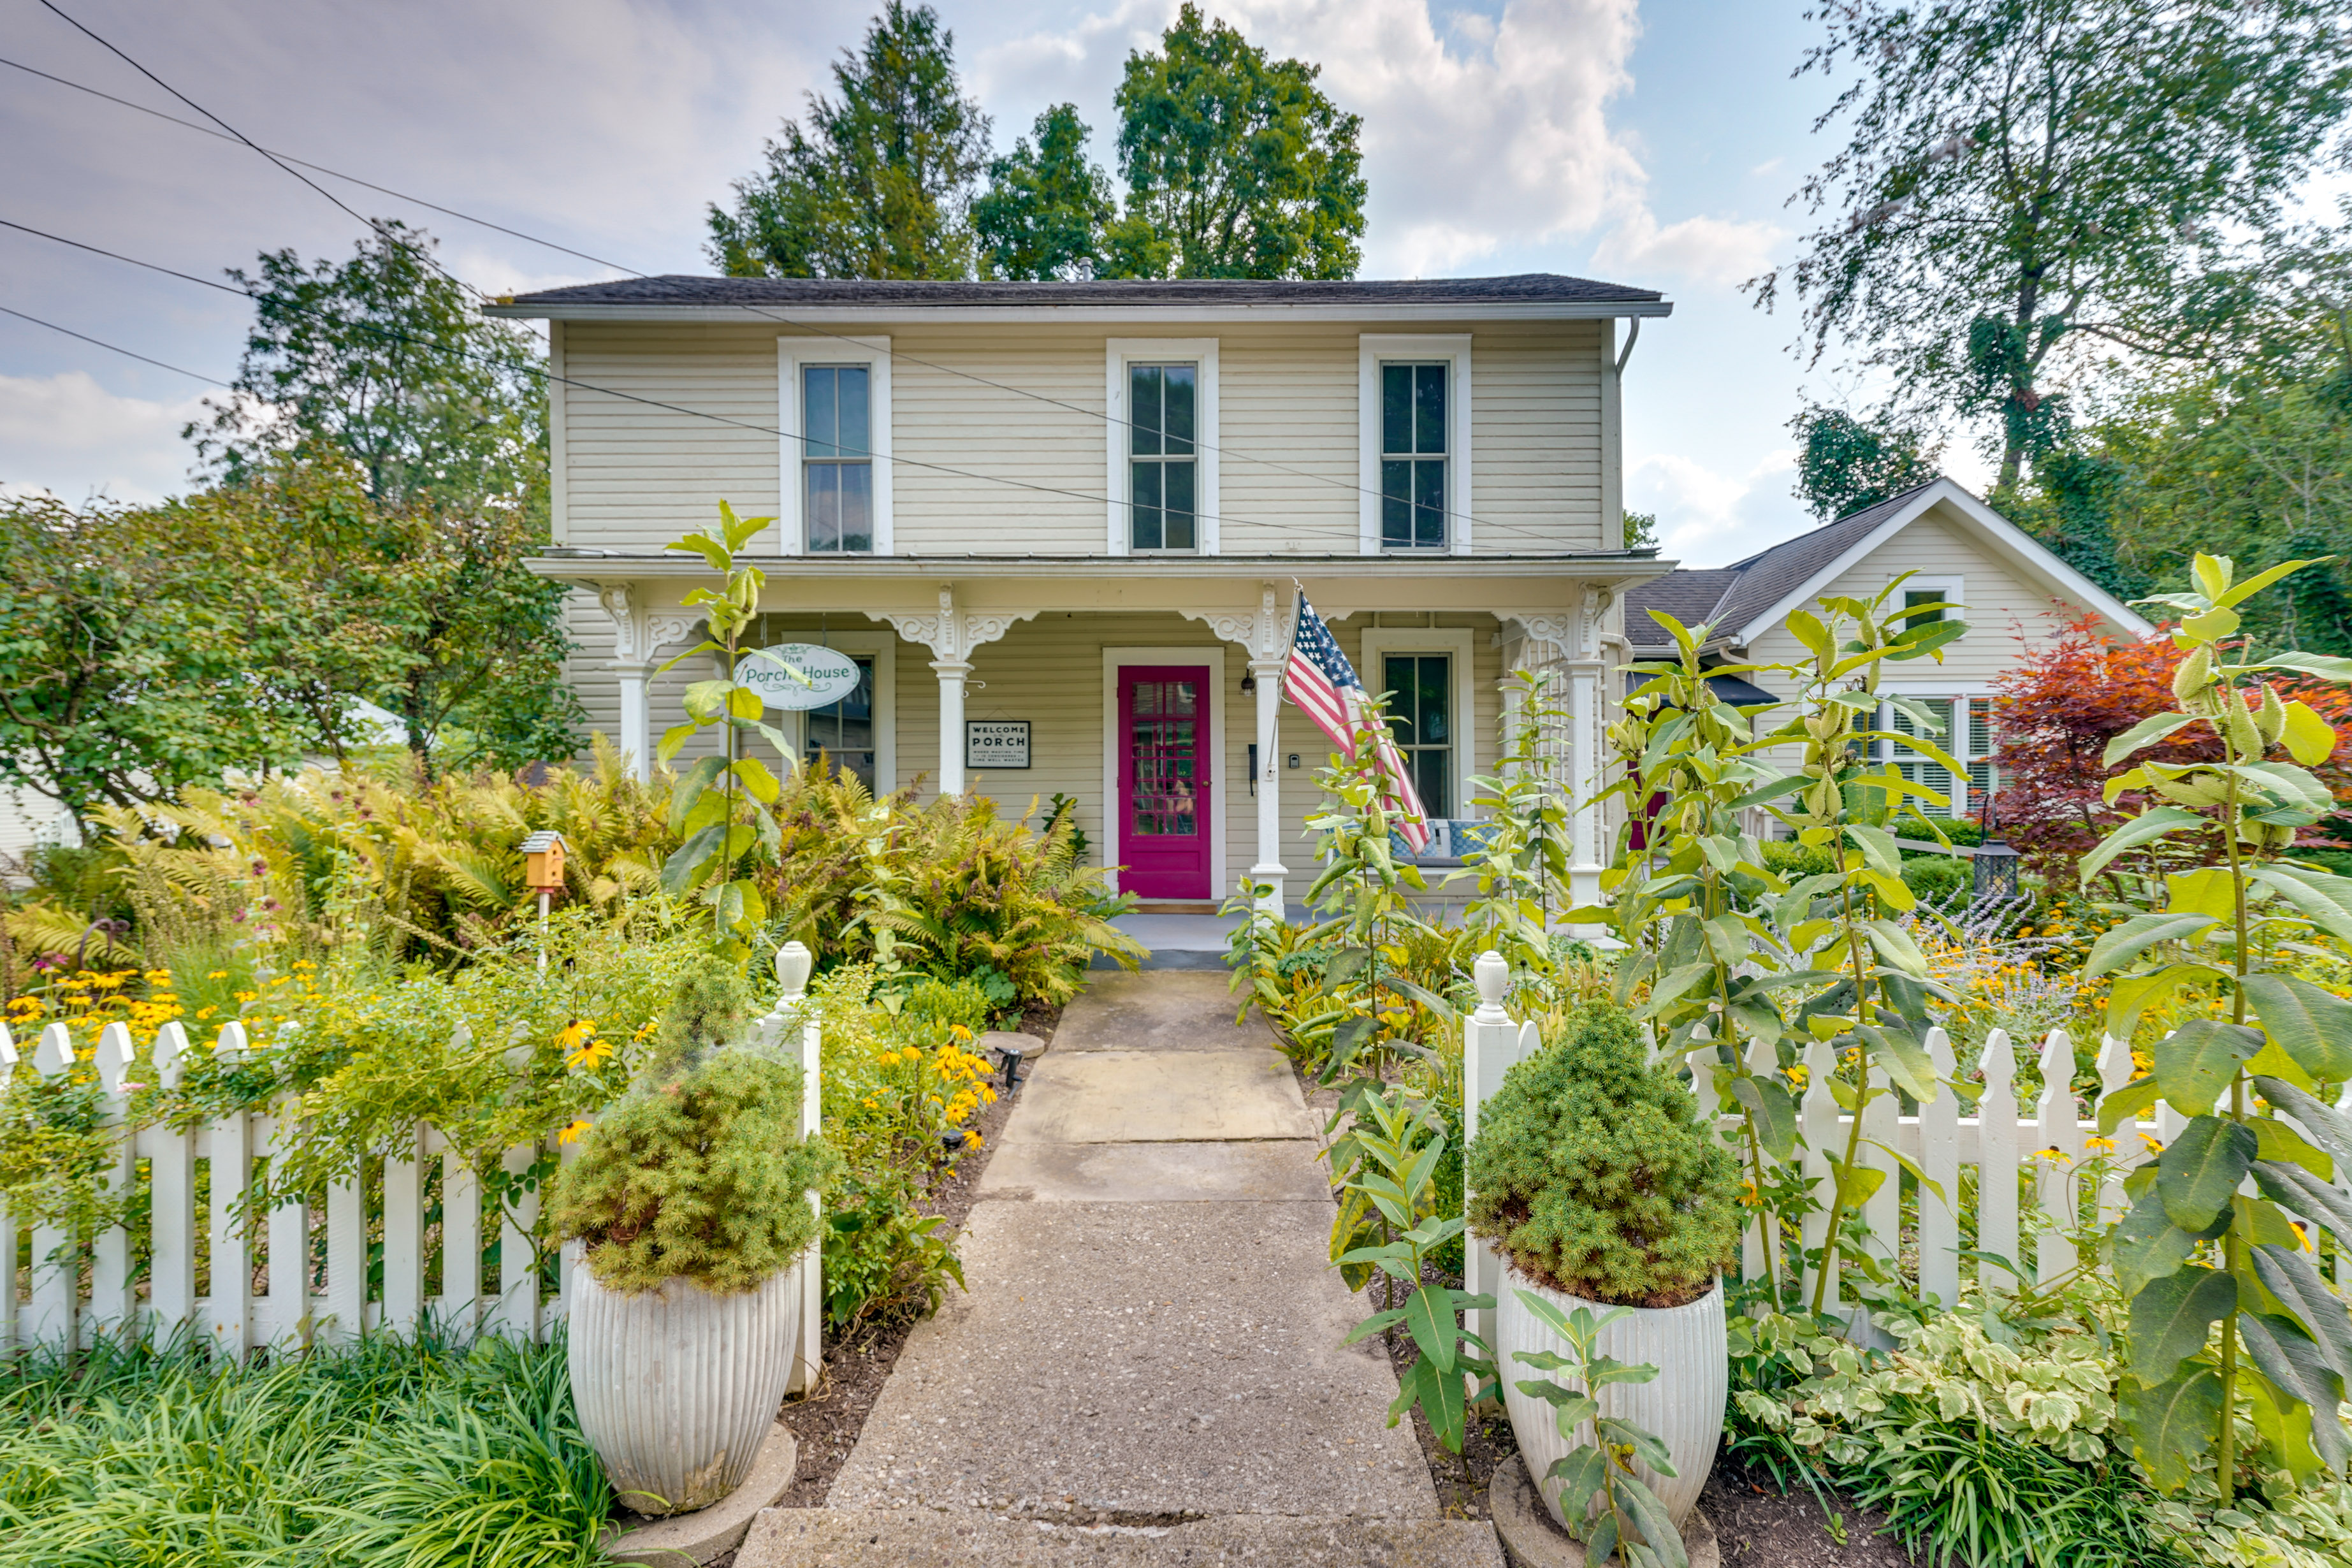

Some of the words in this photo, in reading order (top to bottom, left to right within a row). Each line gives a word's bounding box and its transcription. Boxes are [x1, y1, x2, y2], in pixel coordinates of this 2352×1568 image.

[782, 655, 802, 664] The
[802, 665, 850, 679] House
[973, 737, 1025, 746] PORCH
